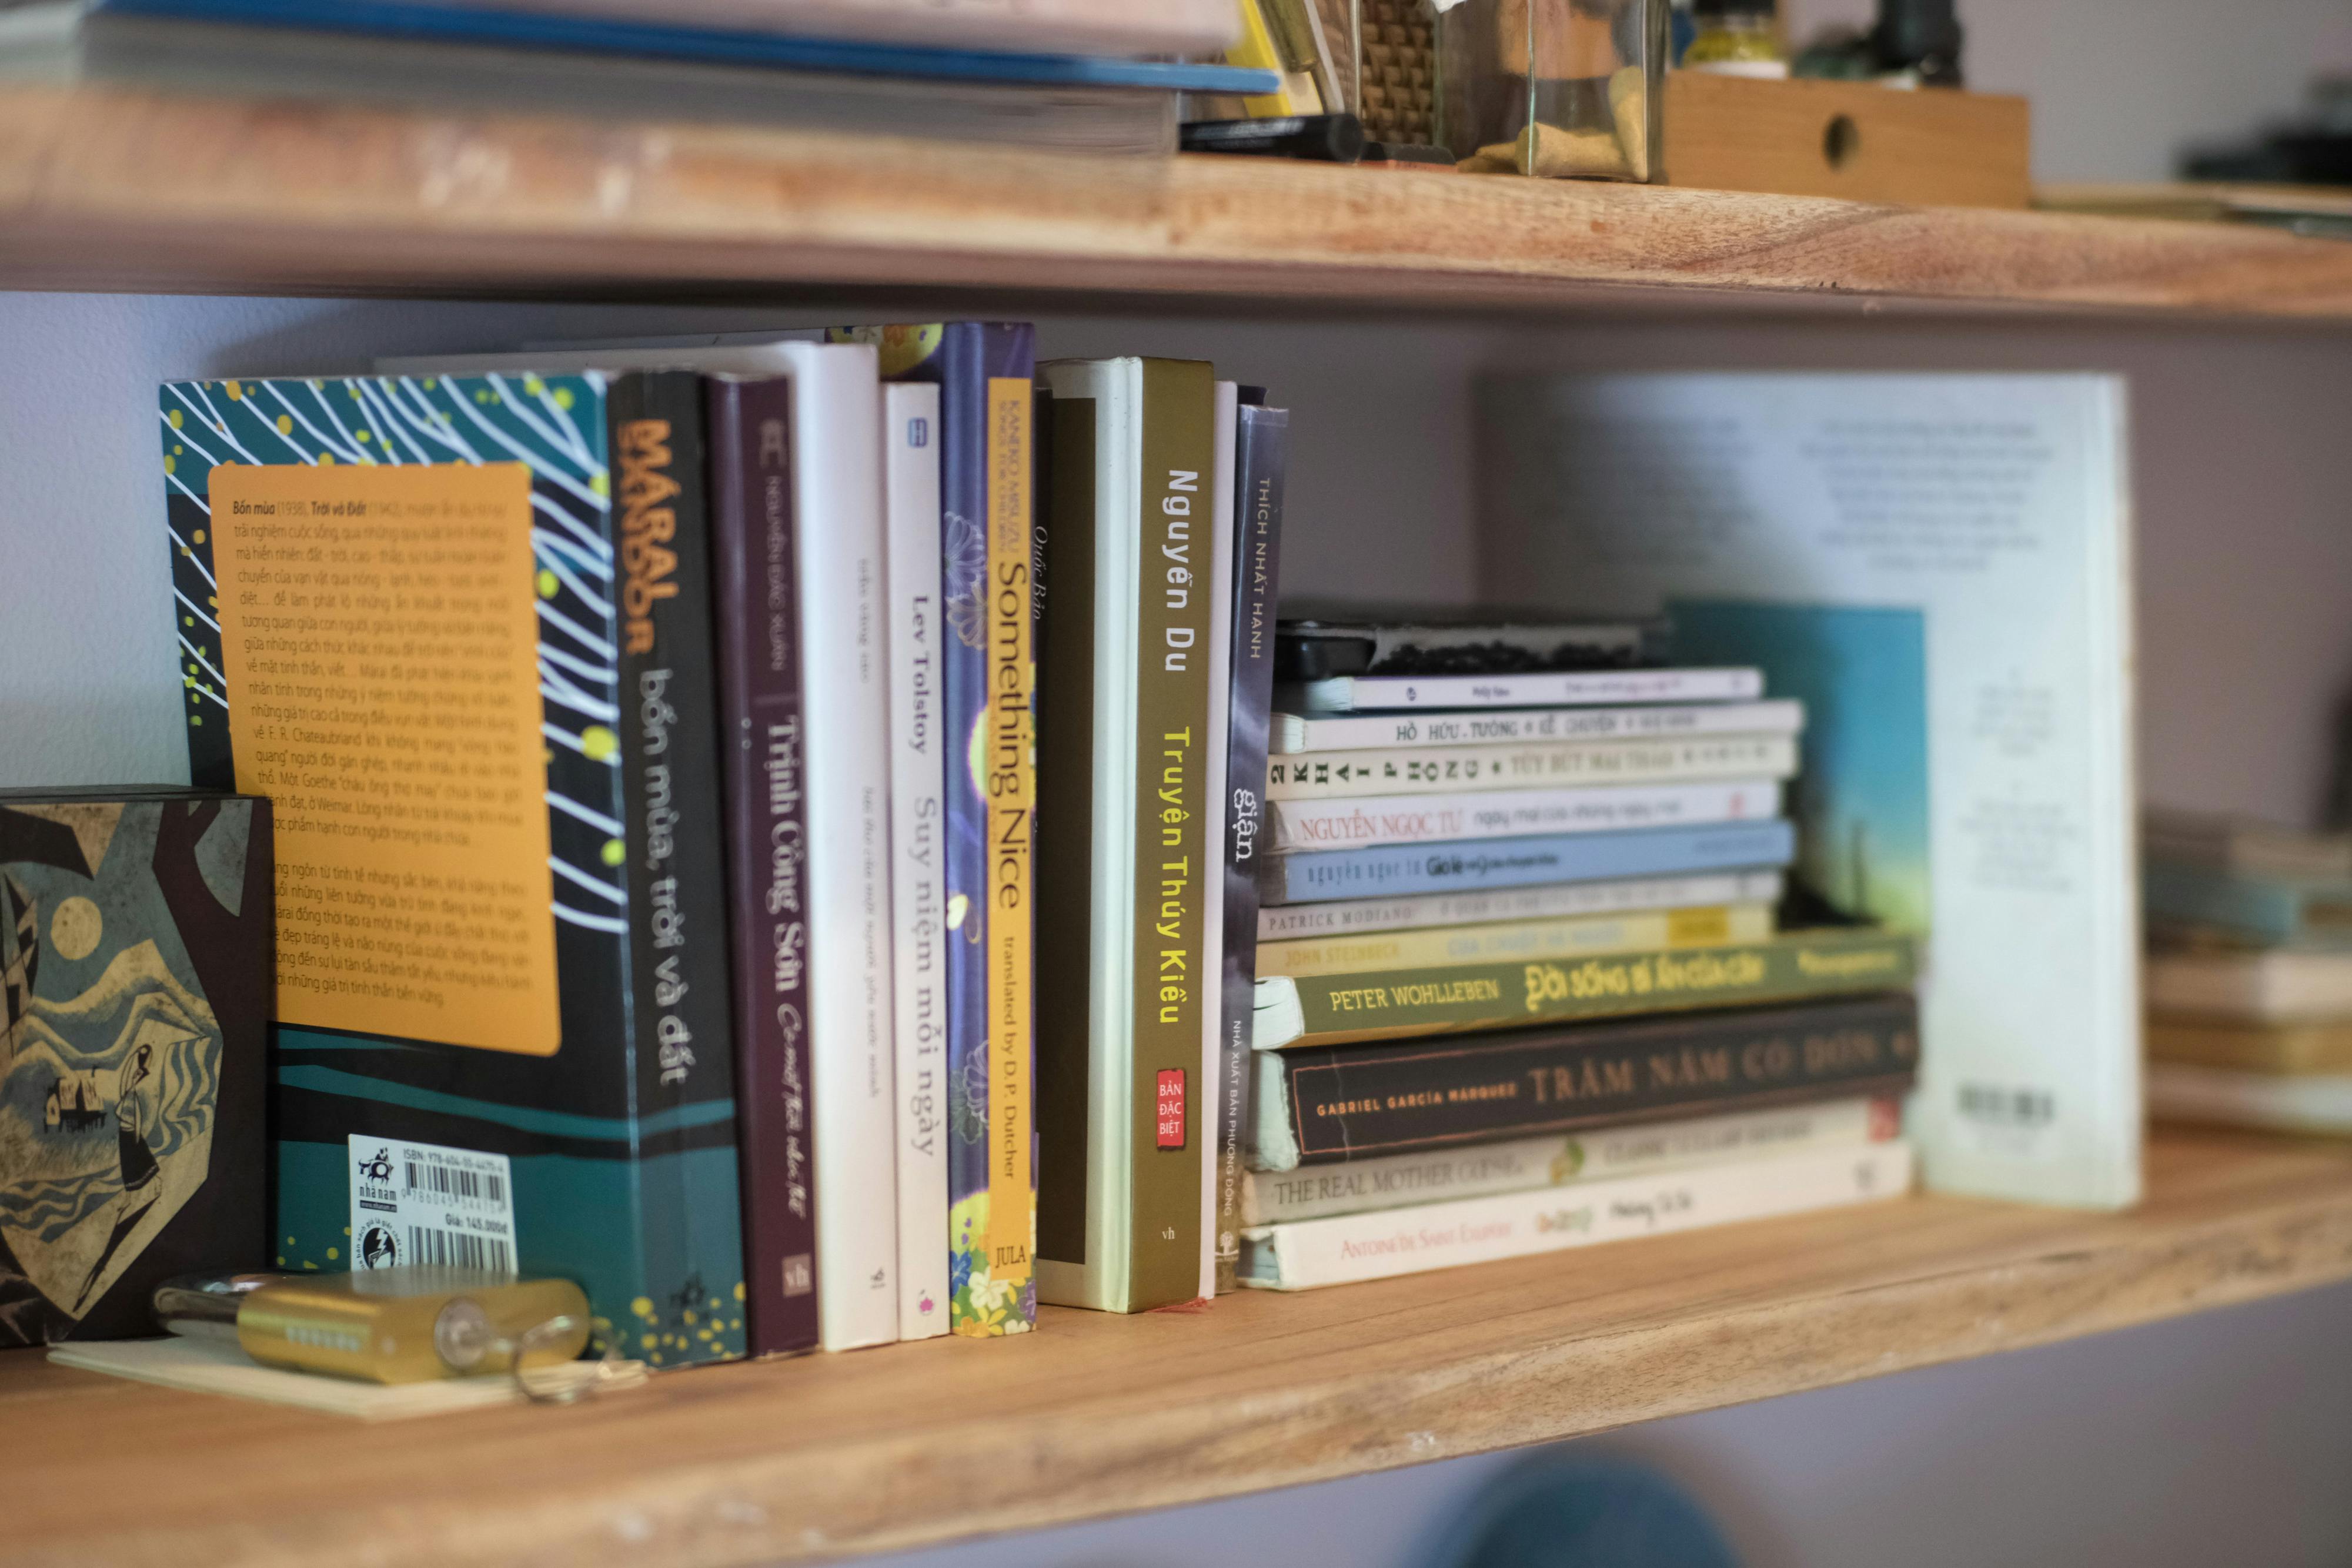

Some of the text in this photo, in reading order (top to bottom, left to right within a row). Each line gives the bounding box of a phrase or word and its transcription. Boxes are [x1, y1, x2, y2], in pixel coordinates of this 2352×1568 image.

[1007, 400, 1021, 553] KANEKO MISUZU
[233, 500, 276, 515] Bốn mùa
[235, 523, 287, 541] trải nghiệm
[236, 544, 272, 561] mà hiển
[238, 567, 292, 586] chuyển của
[1031, 525, 1049, 620] Quốc Bảo
[1162, 470, 1198, 672] Nguyễn Du
[1248, 477, 1273, 659] THÍCH NHẤT HẠNH
[239, 590, 286, 608] diệt... để
[241, 615, 295, 633] tương quan
[244, 636, 322, 656] giữa những cách
[246, 657, 299, 675] về mặt tinh
[908, 594, 932, 757] Lev Tolstoy
[248, 681, 323, 702] nhân tính trong
[251, 704, 328, 723] những giá cao
[253, 724, 289, 741] về R.
[988, 560, 1029, 910] Something Nice
[1396, 723, 1418, 741] HỒ
[290, 751, 318, 768] người
[258, 768, 299, 787] thổ. Một
[1270, 764, 1285, 784] 2
[288, 816, 340, 835] phẩm hạnh
[1231, 788, 1258, 863] giận
[1299, 809, 1377, 841] NGUYỄN
[1379, 811, 1435, 838] NGỌC
[763, 714, 805, 992] Trịnh Công Sơn
[292, 862, 365, 882] ngôn tinh tế
[639, 668, 697, 1086] bốn mùa, trời và đất
[1155, 726, 1191, 1024] Truyện Thúy Kiều
[291, 884, 343, 904] những liên
[296, 905, 372, 929] đồng thời tạo ra
[1269, 905, 1412, 932] PATRICK MODIANO
[282, 927, 355, 949] đẹp tráng lệ và
[298, 951, 360, 972] đến sự lụi tàn
[1284, 942, 1401, 968] JOHN STEINBECK
[288, 974, 371, 995] những giá trị tinh
[907, 796, 943, 1158] Suy niệm mỗi ngày
[1329, 988, 1389, 1011] PETER
[1390, 979, 1500, 1007] WOHLLEBEN
[1231, 1019, 1243, 1048] NHÀ
[1000, 936, 1018, 1180] translated by D. P. Dutcher
[1230, 1052, 1241, 1086] XUẤT
[1159, 1083, 1182, 1096] BẢN
[1316, 1098, 1381, 1117] GABRIEL
[1387, 1090, 1444, 1110] GARCÍA
[1448, 1081, 1518, 1102] MÁRQUEZ
[1529, 1057, 1635, 1104] TRĂM
[1158, 1103, 1182, 1119] ĐẶC
[1227, 1089, 1240, 1117] BẢN
[1159, 1122, 1181, 1137] BIỆT
[1274, 1160, 1456, 1206] THE REAL MOTHER
[377, 1188, 397, 1201] nam
[1222, 1178, 1237, 1217] ĐÔNG
[1161, 1226, 1177, 1241] vh
[995, 1246, 1027, 1269] JULA
